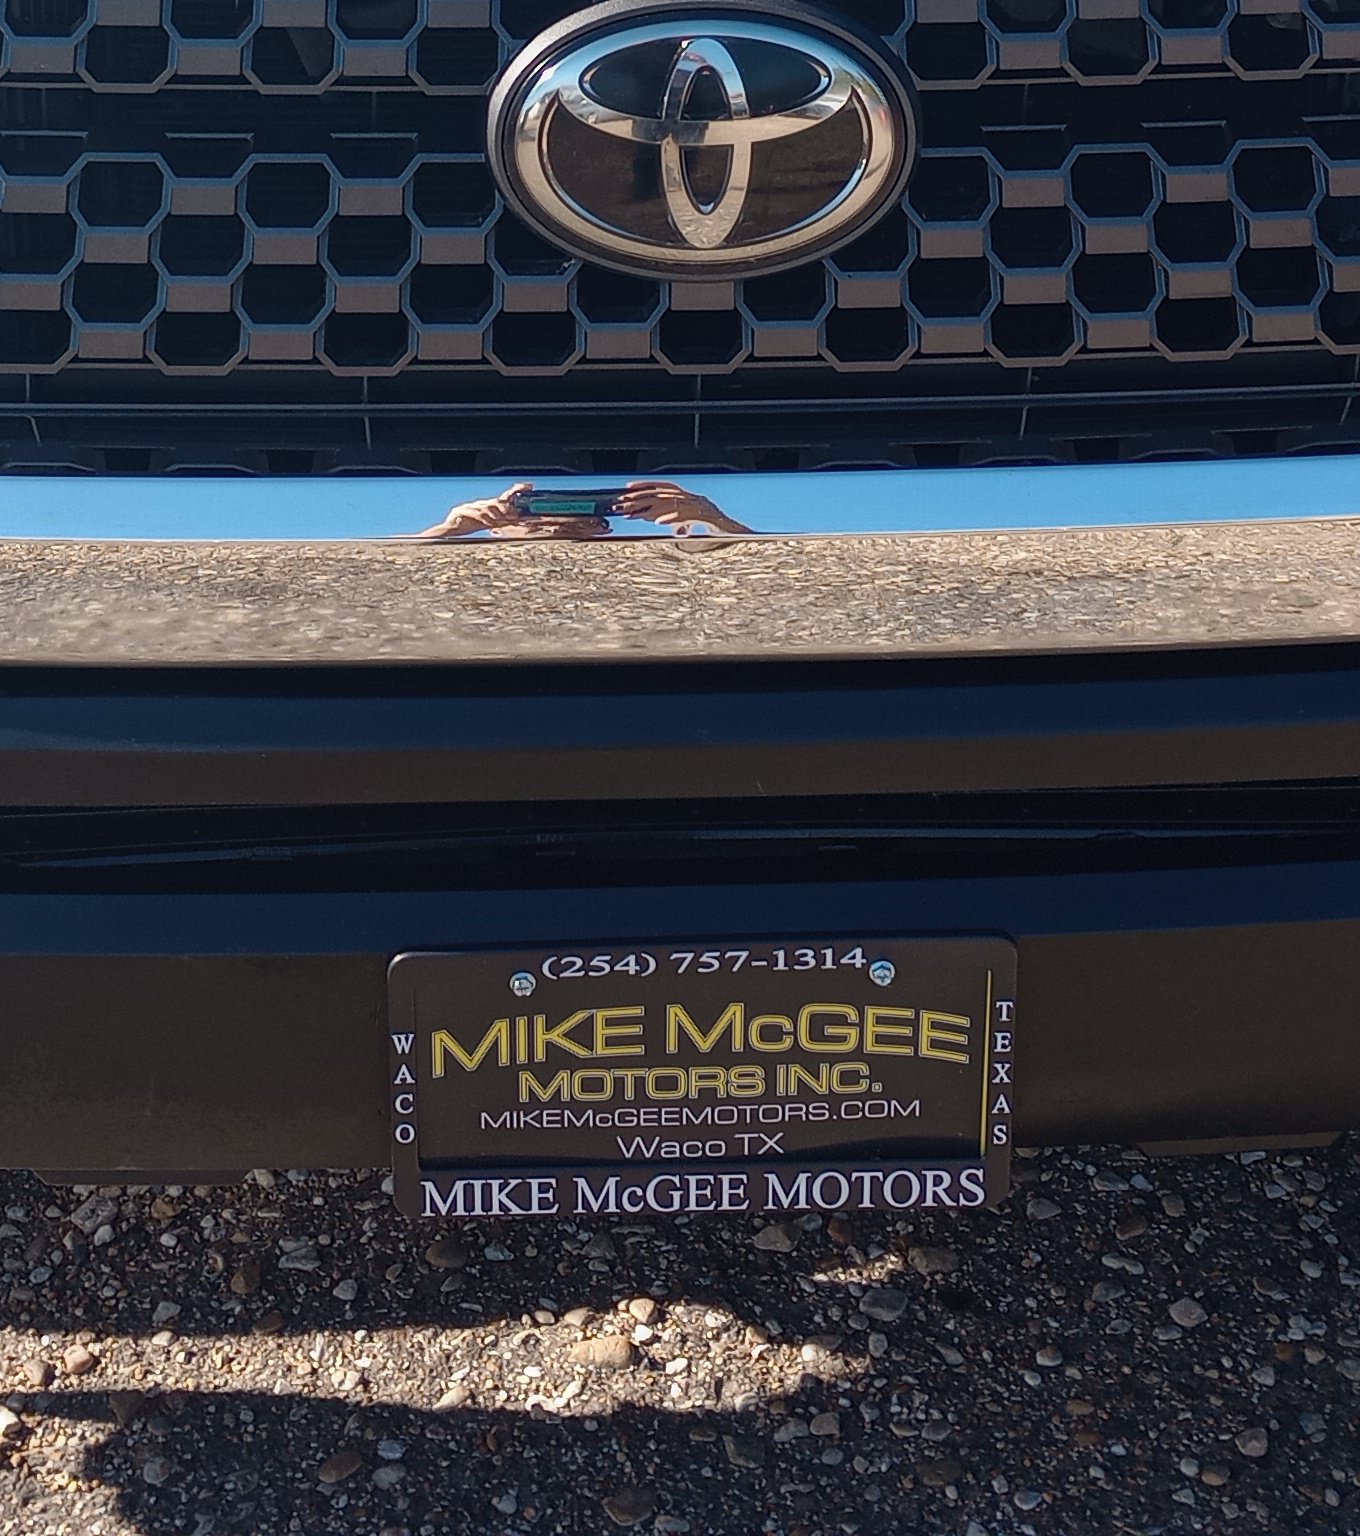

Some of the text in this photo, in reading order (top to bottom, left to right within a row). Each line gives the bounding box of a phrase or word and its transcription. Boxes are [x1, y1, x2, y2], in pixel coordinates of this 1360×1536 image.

[542, 947, 867, 980] (254) 757-1314
[431, 1002, 971, 1079] MIKE McGEE
[391, 1033, 416, 1144] WACO
[519, 1062, 883, 1103] MOTORS INC.
[992, 1001, 1014, 1145] TEXAS
[616, 1132, 785, 1159] Waco TX
[420, 1168, 986, 1217] MIKE McGEE MOTORS
